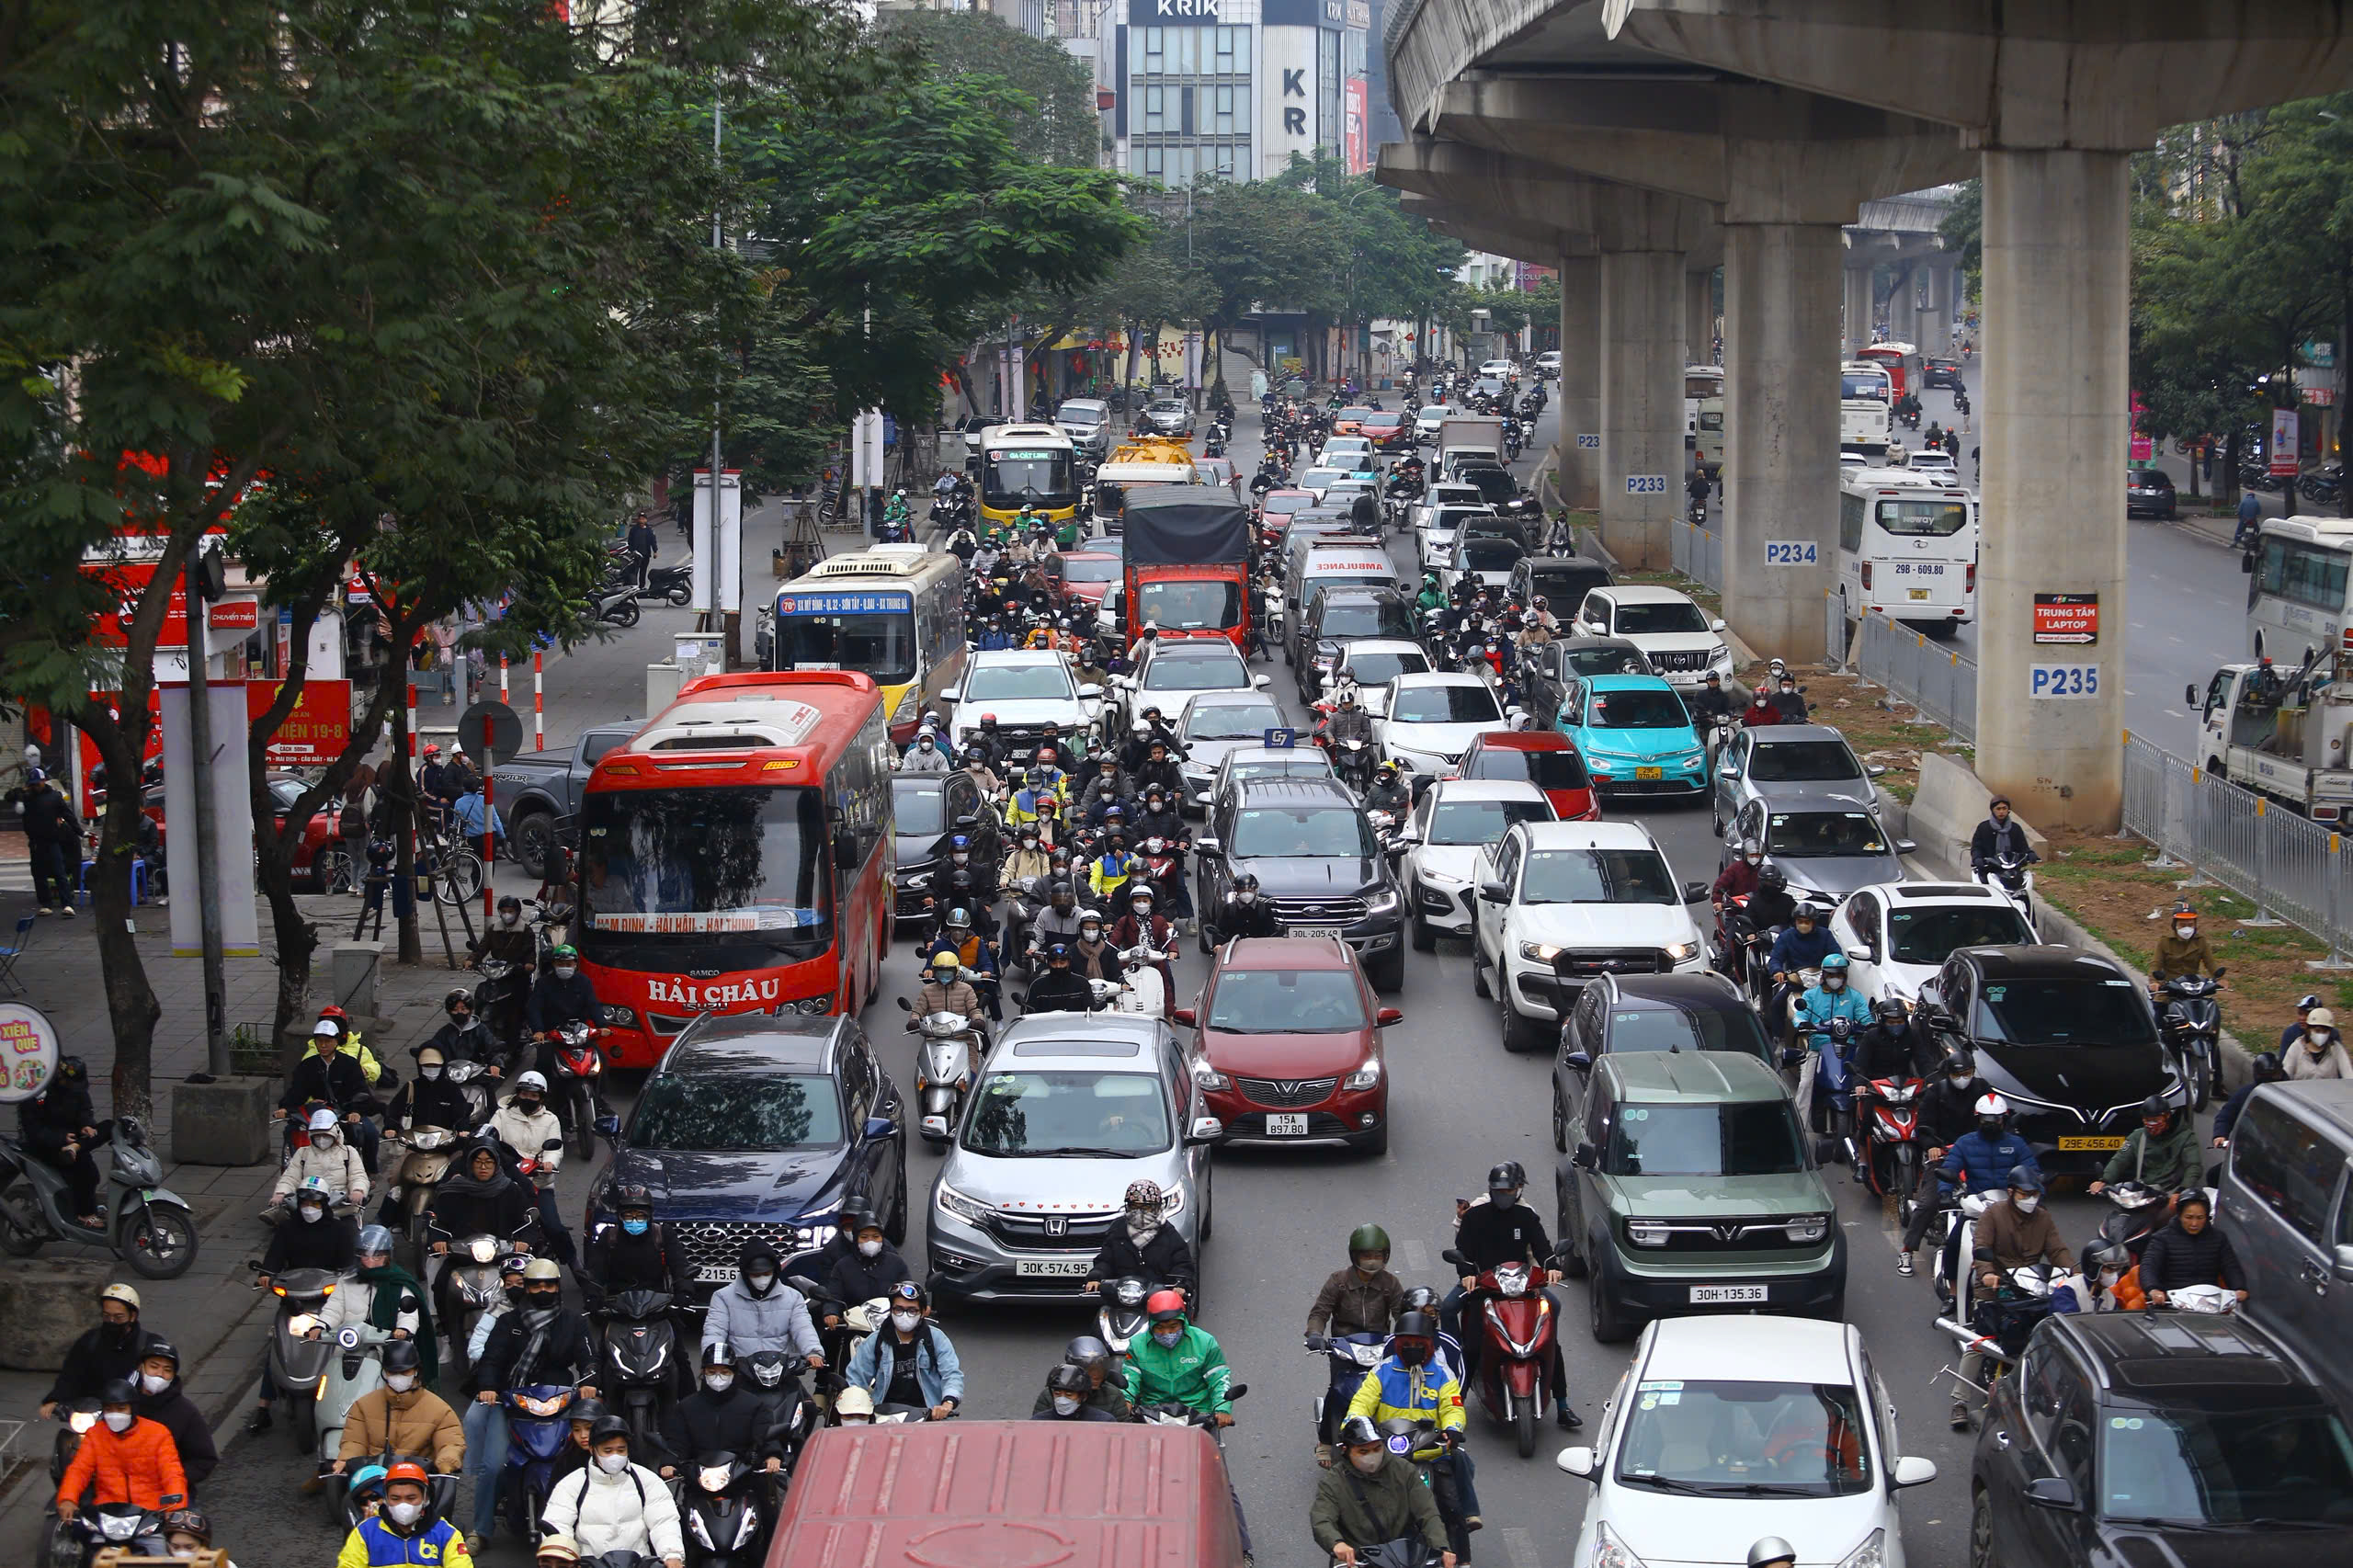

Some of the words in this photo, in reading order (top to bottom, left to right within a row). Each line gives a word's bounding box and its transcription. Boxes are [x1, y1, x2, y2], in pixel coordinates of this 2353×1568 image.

[1157, 0, 1219, 16] KRIK
[1578, 436, 1600, 448] P23
[1627, 477, 1665, 493] P233
[1768, 544, 1817, 562] P234
[1895, 564, 1911, 574] 29B
[1917, 565, 1944, 575] 609.80
[2037, 608, 2074, 618] TRUNG
[2075, 607, 2096, 617] TÂM
[2046, 620, 2087, 629] LAPTOP
[2032, 668, 2097, 695] P235
[278, 722, 308, 740] VIỆN
[313, 724, 342, 738] 19-8
[492, 772, 528, 785] RAPTOR
[648, 977, 698, 1004] HẢI
[704, 978, 779, 1003] CHÂU
[682, 1002, 729, 1011] ISUZU
[17, 1037, 38, 1051] QUE
[1279, 1115, 1296, 1124] 15A
[1270, 1125, 1303, 1133] 897.80
[2064, 1139, 2120, 1149] 29E-456.40
[696, 1269, 741, 1279] -215.6
[1022, 1263, 1088, 1274] 30K-574.95
[1697, 1289, 1762, 1300] 30H-135.36
[419, 1538, 438, 1559] be
